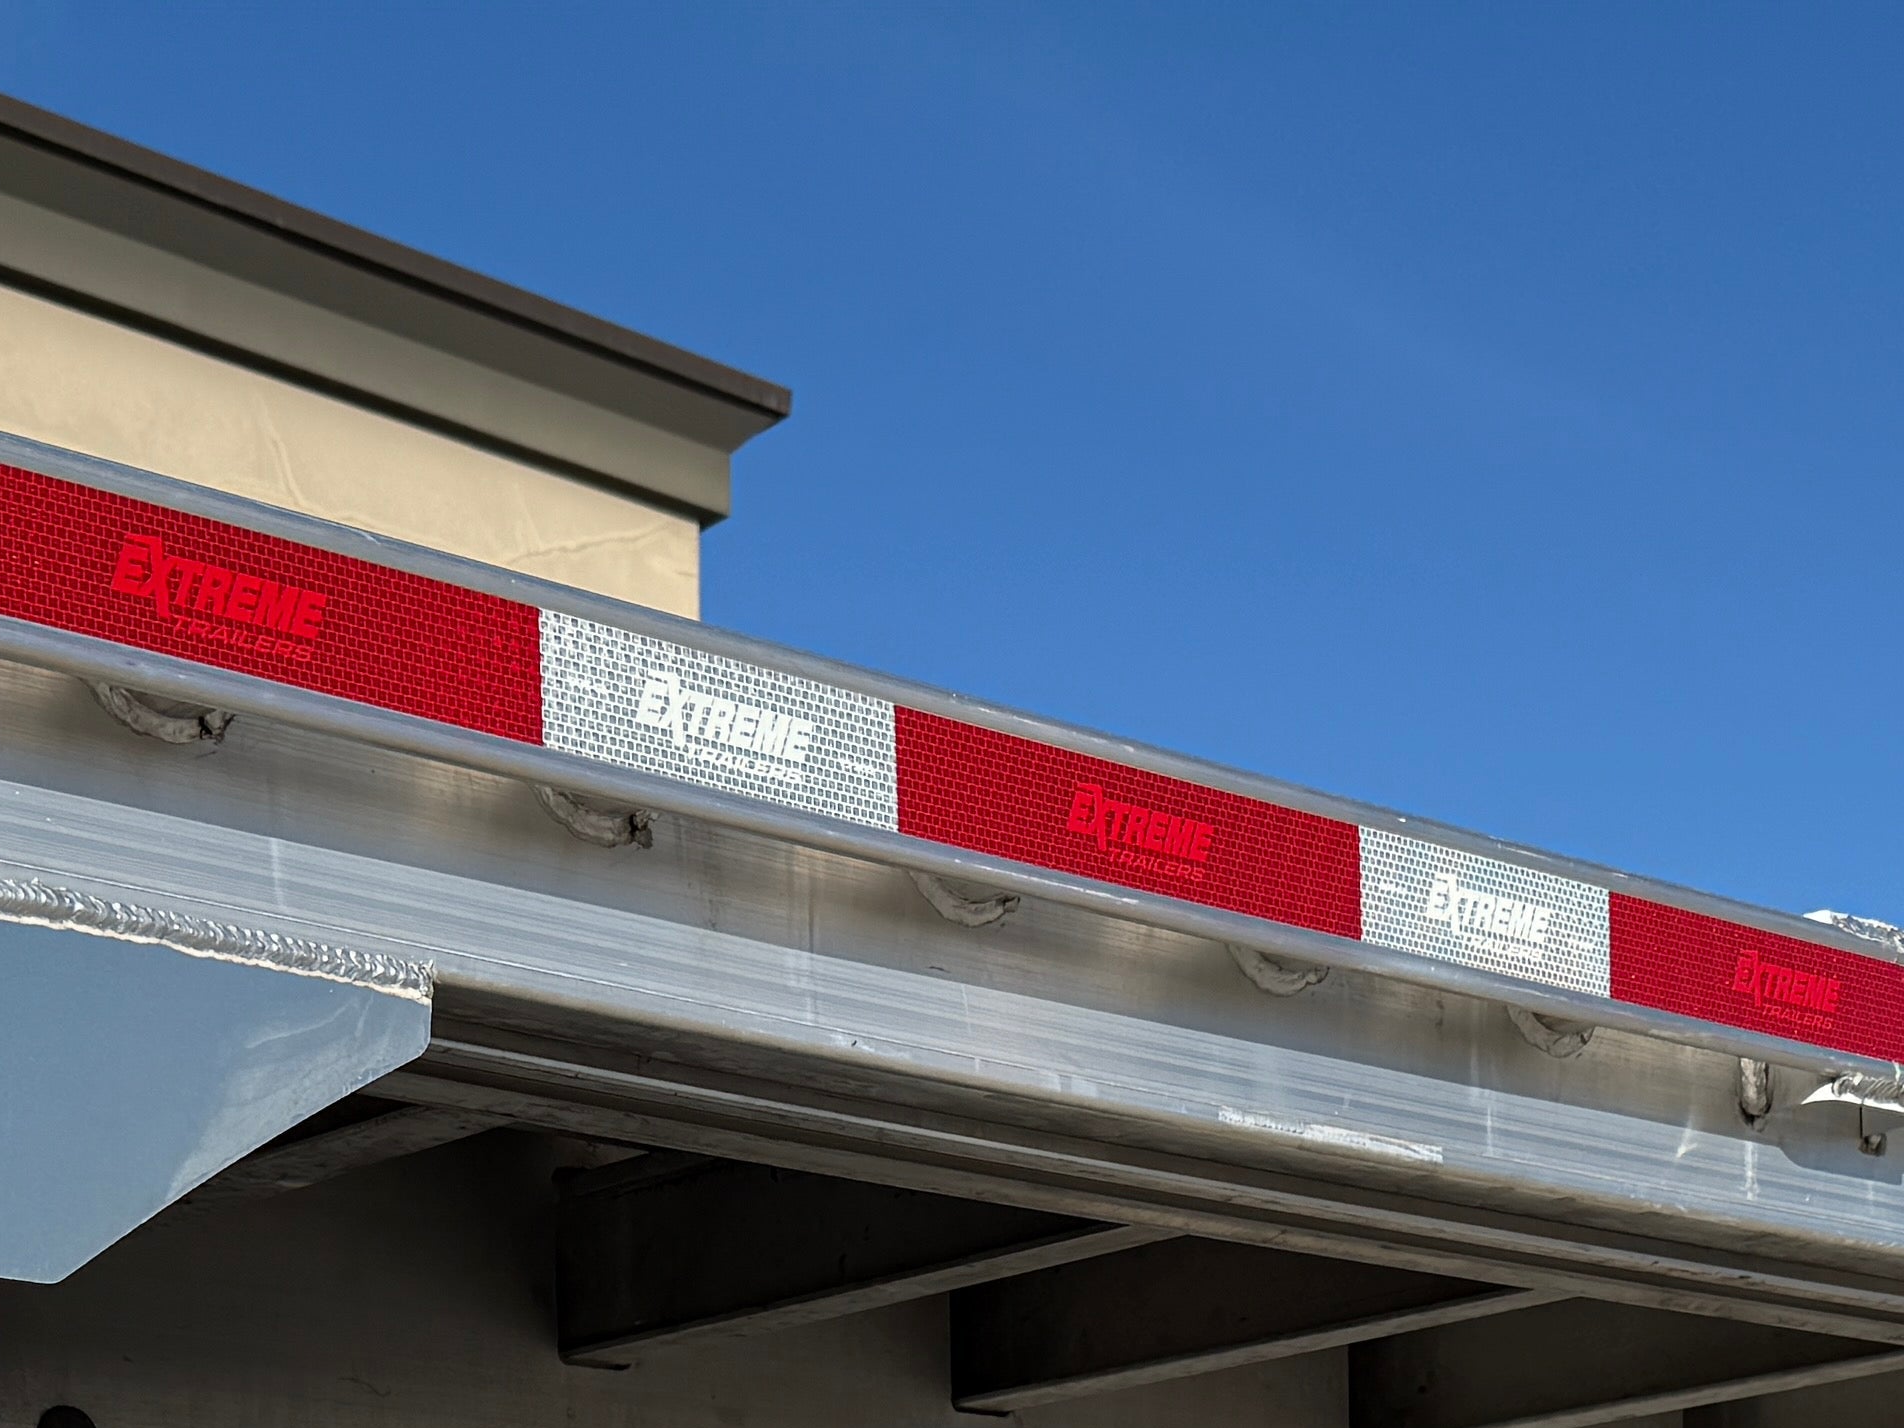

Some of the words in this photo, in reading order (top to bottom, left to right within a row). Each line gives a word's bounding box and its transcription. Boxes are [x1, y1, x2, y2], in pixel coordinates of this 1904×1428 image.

[111, 533, 326, 640] EXTREME
[175, 617, 313, 661] TRAILERS
[635, 670, 813, 764] EXTREME
[1067, 783, 1214, 861] EXTREME
[1110, 850, 1204, 881] TRAILERS
[1427, 872, 1549, 943] EXTREME
[1732, 949, 1840, 1013] EXTREME
[1762, 1004, 1832, 1030] TRAILERS
